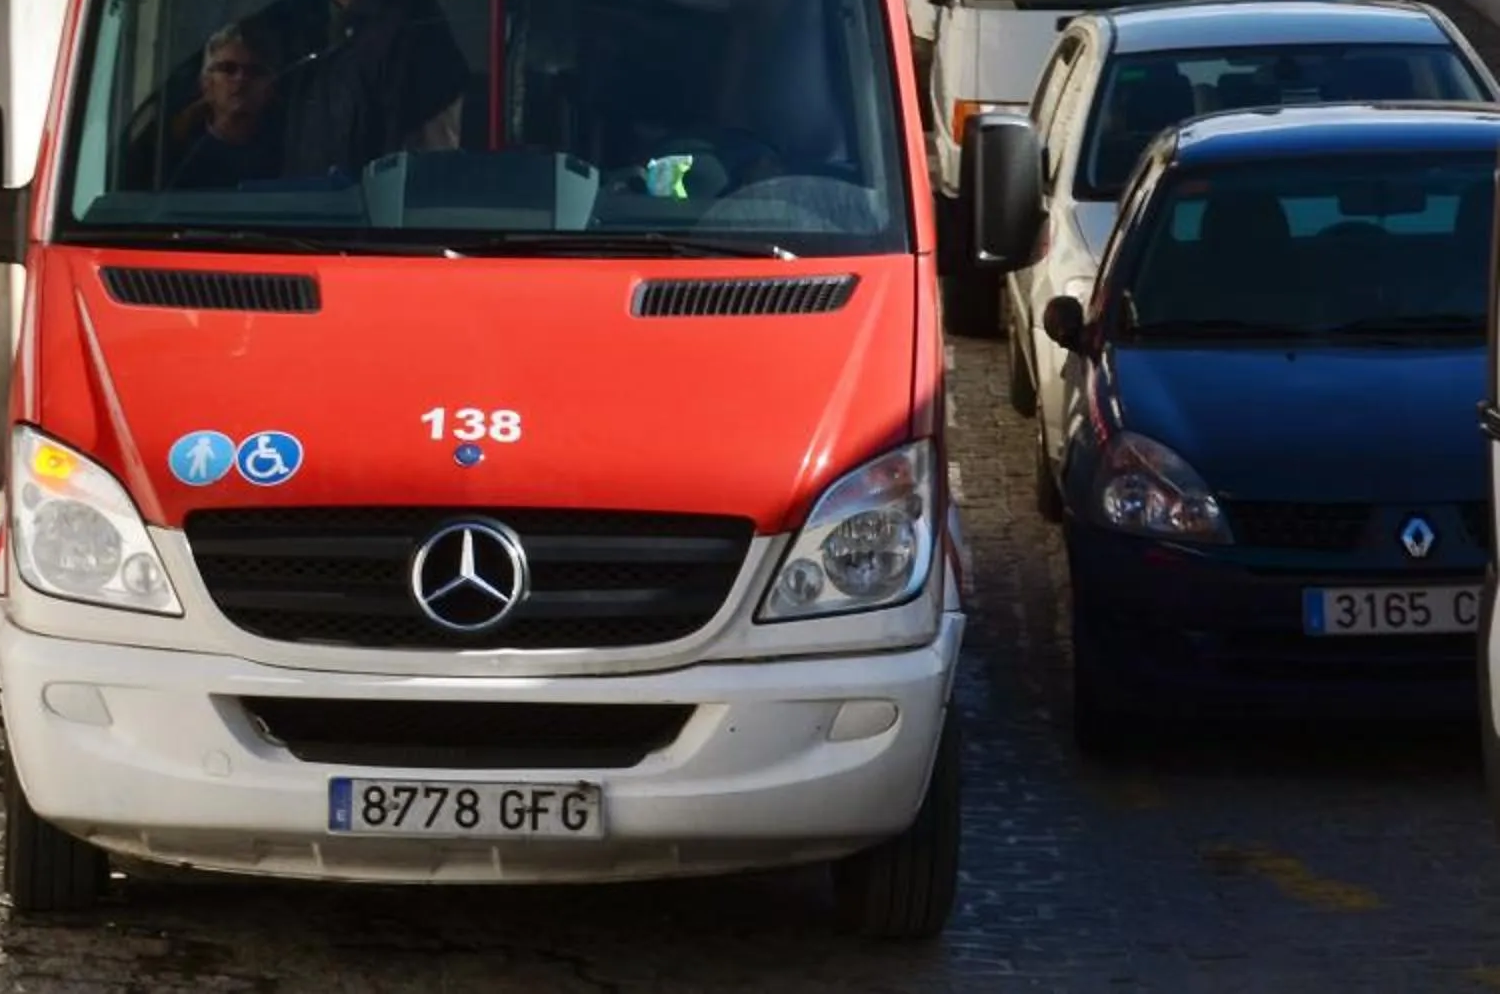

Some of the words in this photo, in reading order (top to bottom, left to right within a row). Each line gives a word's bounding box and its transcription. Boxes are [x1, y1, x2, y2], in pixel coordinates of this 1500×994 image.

[420, 406, 524, 444] 138
[1335, 591, 1432, 629] 3165
[1452, 590, 1484, 626] C
[362, 785, 481, 829] 8778
[499, 788, 589, 832] GFG
